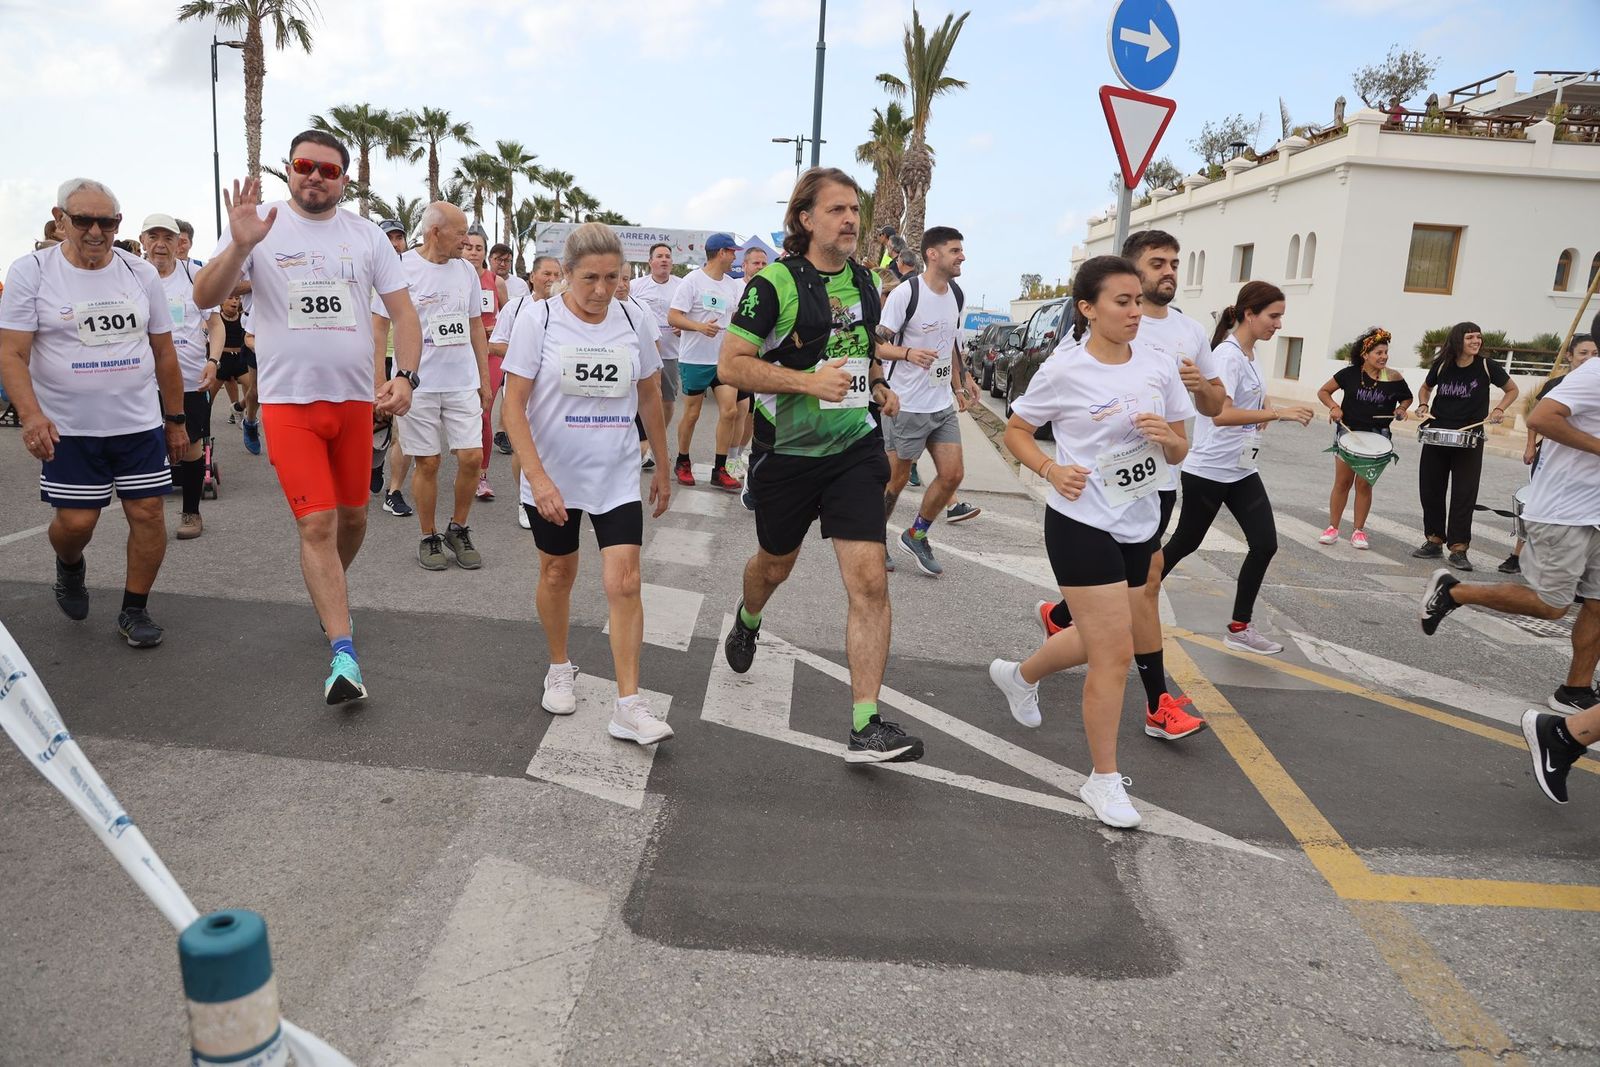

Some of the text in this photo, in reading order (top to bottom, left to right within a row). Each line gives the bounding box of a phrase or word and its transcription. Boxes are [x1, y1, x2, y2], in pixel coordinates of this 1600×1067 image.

[615, 231, 656, 241] ARRERA
[300, 296, 342, 313] 386
[711, 297, 717, 305] 9
[84, 313, 137, 332] 1301
[438, 323, 464, 336] 648
[575, 363, 618, 382] 542
[1251, 447, 1259, 460] 7
[1115, 456, 1157, 487] 389
